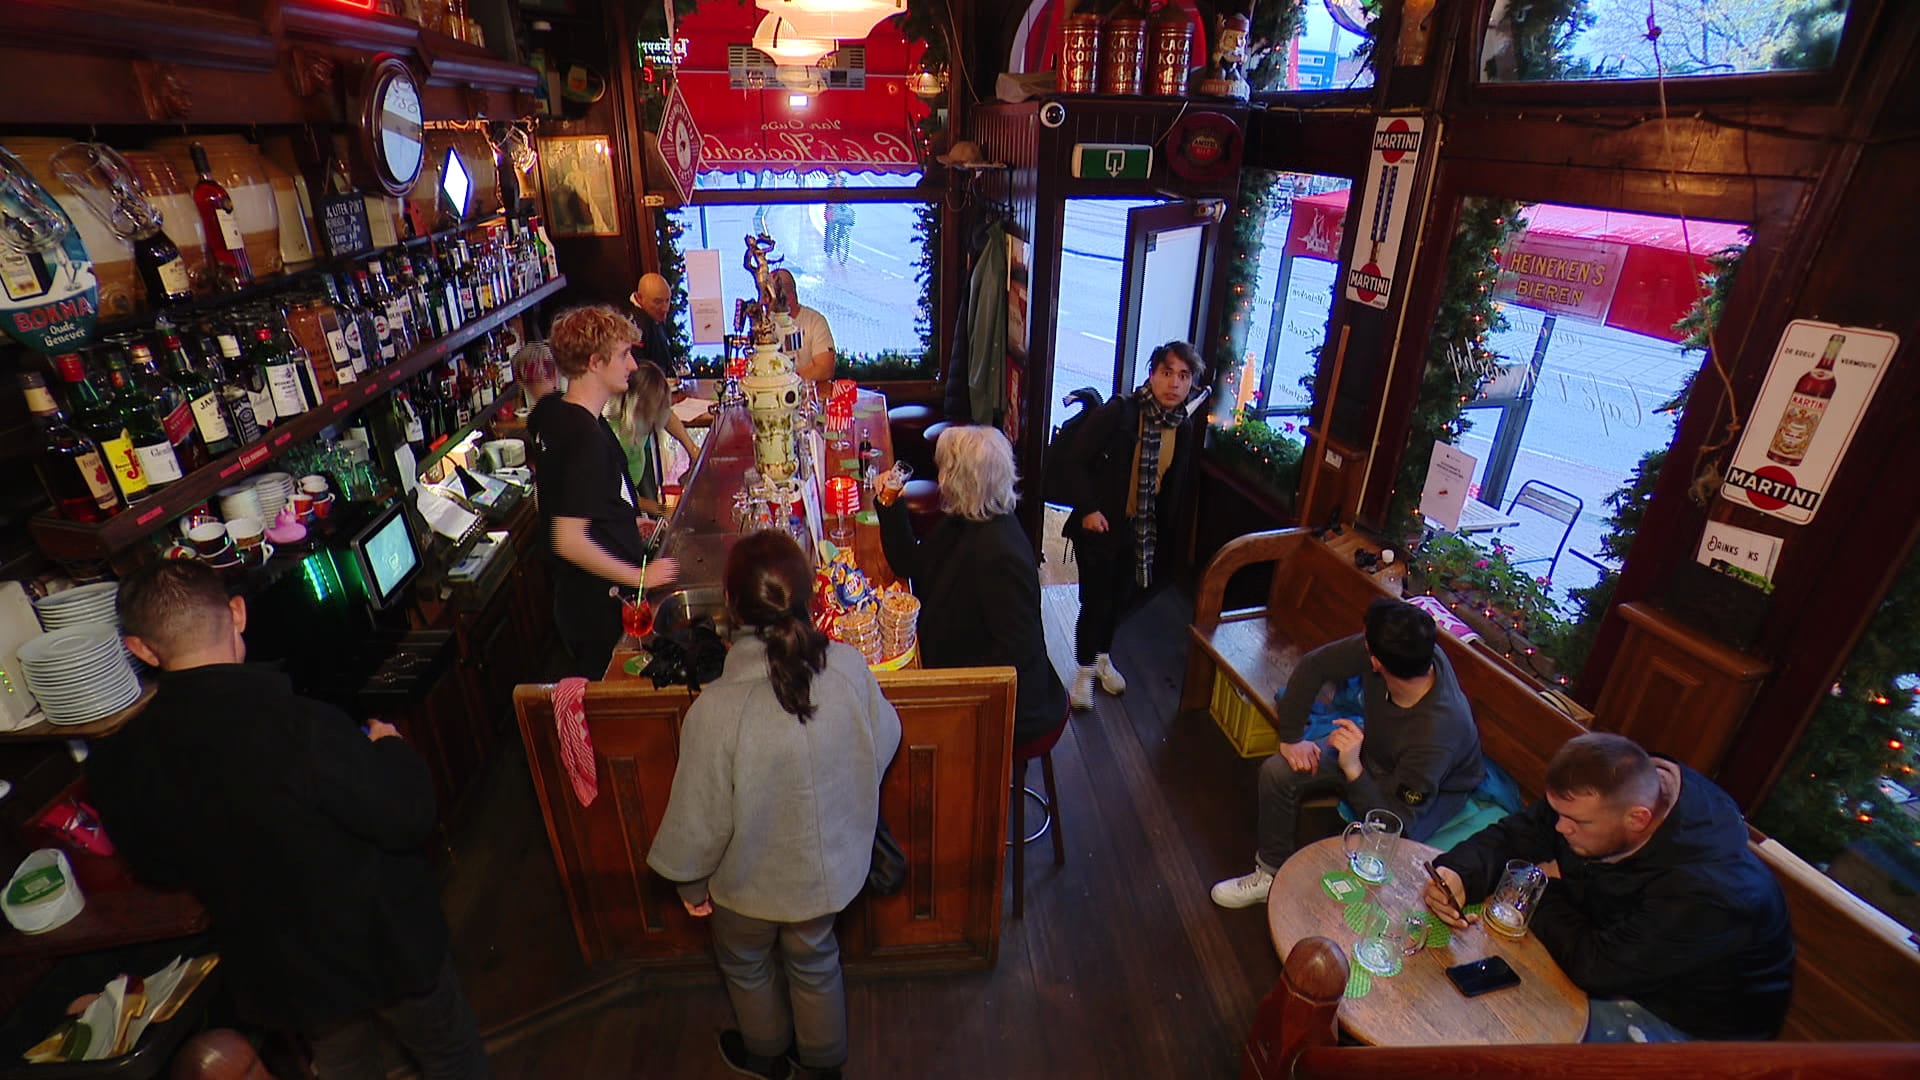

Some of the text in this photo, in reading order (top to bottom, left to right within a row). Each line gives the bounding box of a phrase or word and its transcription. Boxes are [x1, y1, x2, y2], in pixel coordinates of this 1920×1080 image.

[1375, 133, 1419, 149] MARTINI
[1510, 252, 1606, 286] HEINEKEN'S
[1350, 271, 1390, 295] MARTINI
[1517, 280, 1585, 307] BIEREN
[13, 297, 94, 333] BOKMA
[49, 320, 76, 335] Oude
[43, 328, 86, 348] Genever
[1730, 471, 1814, 509] MARTINI
